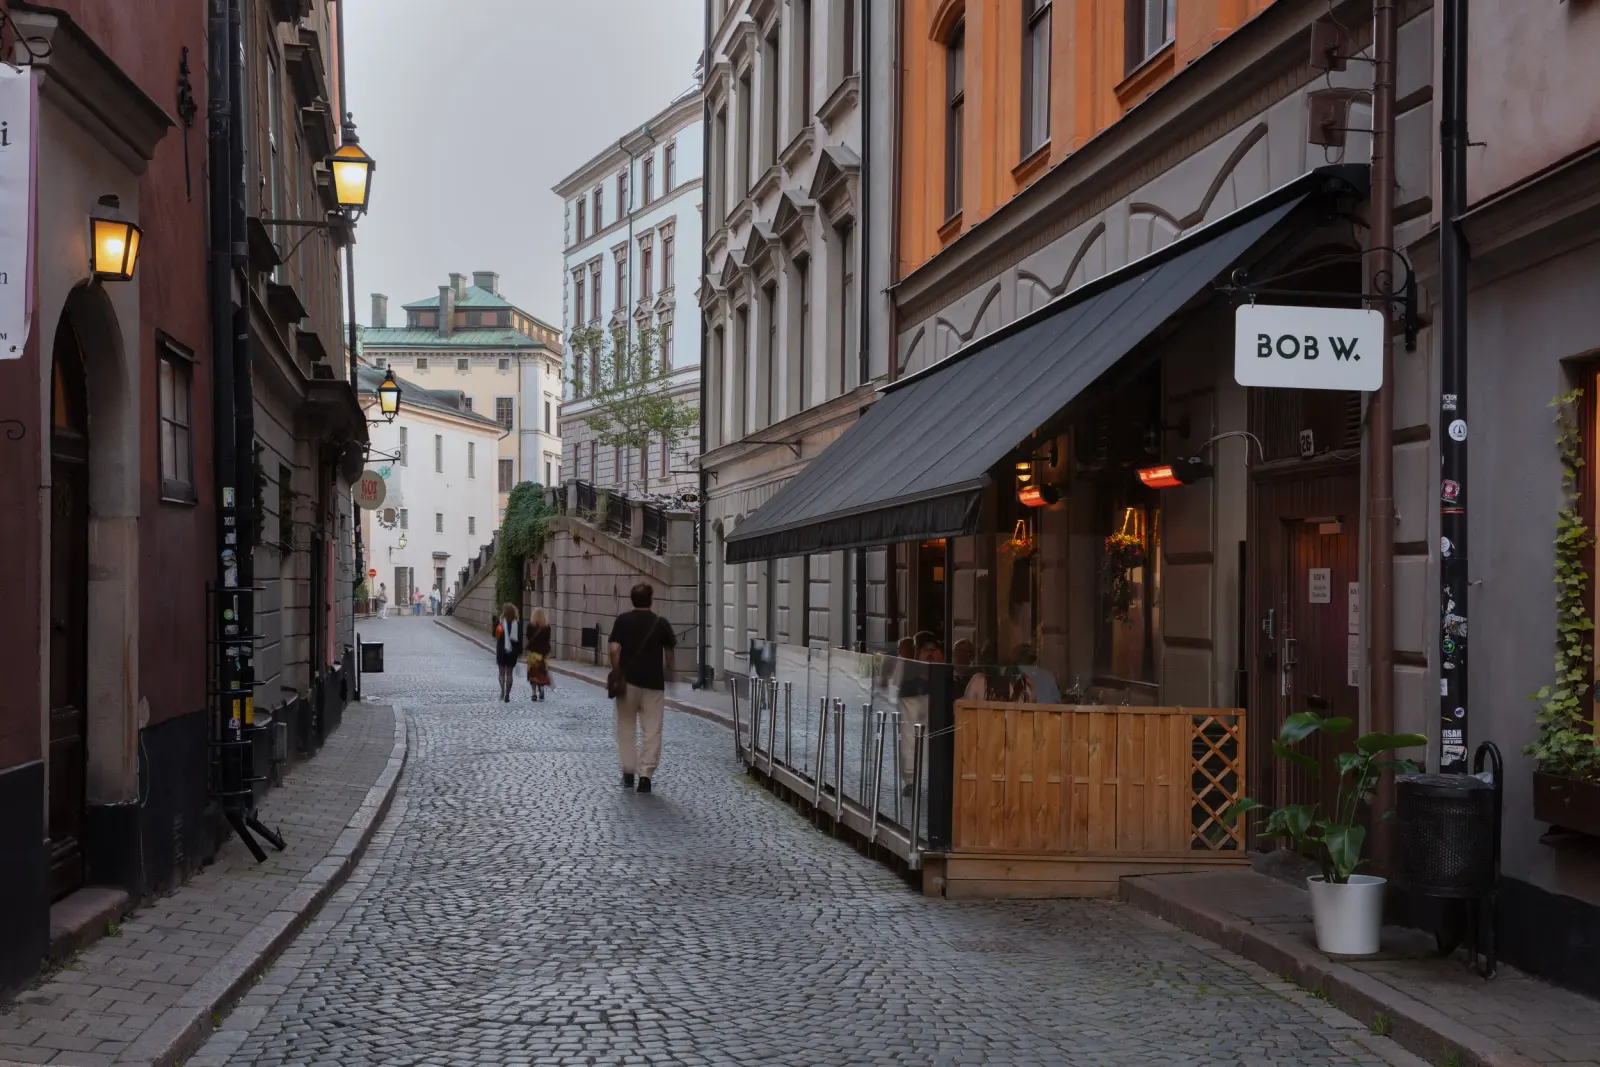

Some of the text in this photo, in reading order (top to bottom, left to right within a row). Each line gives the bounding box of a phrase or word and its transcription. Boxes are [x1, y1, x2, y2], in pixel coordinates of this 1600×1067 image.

[1257, 333, 1361, 362] BOB W.
[1301, 434, 1311, 452] 26
